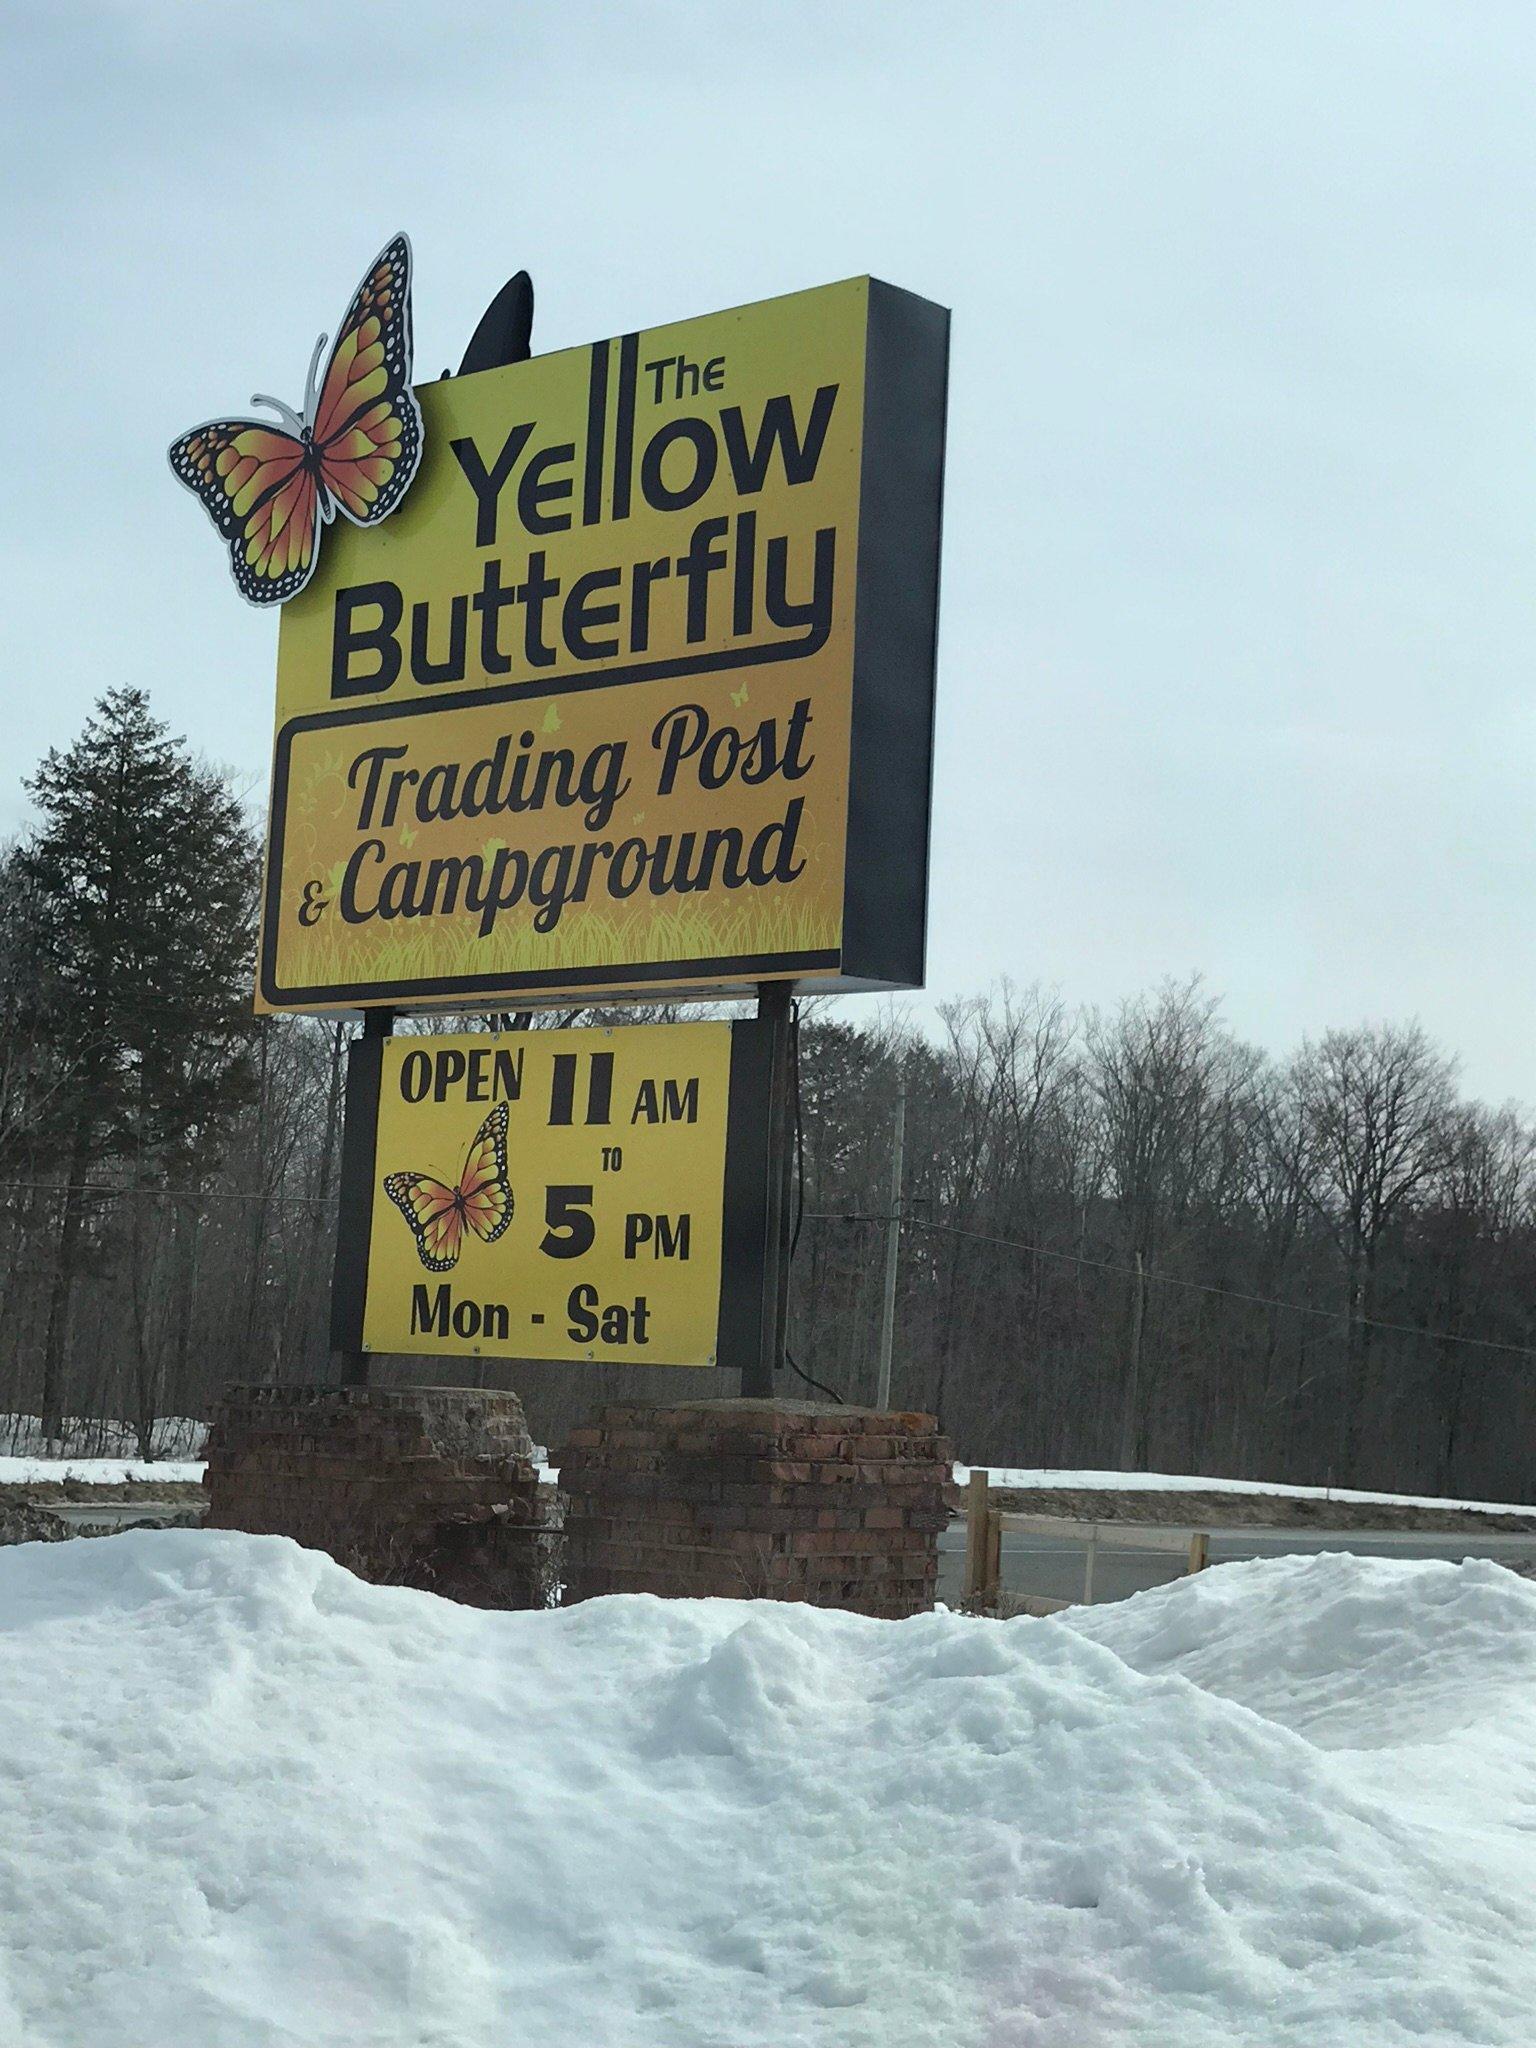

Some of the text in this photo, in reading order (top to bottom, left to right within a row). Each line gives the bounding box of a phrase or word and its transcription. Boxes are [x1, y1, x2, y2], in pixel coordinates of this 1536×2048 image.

[645, 356, 726, 405] The
[450, 332, 840, 548] Yellow
[330, 510, 837, 699] Butterfly
[347, 698, 815, 832] Trading Post
[299, 797, 806, 938] & Campground
[400, 1047, 699, 1126] OPEN 11 AM
[601, 1146, 623, 1172] TO
[539, 1184, 690, 1260] 5 PM
[410, 1283, 651, 1345] Mon - Sat
